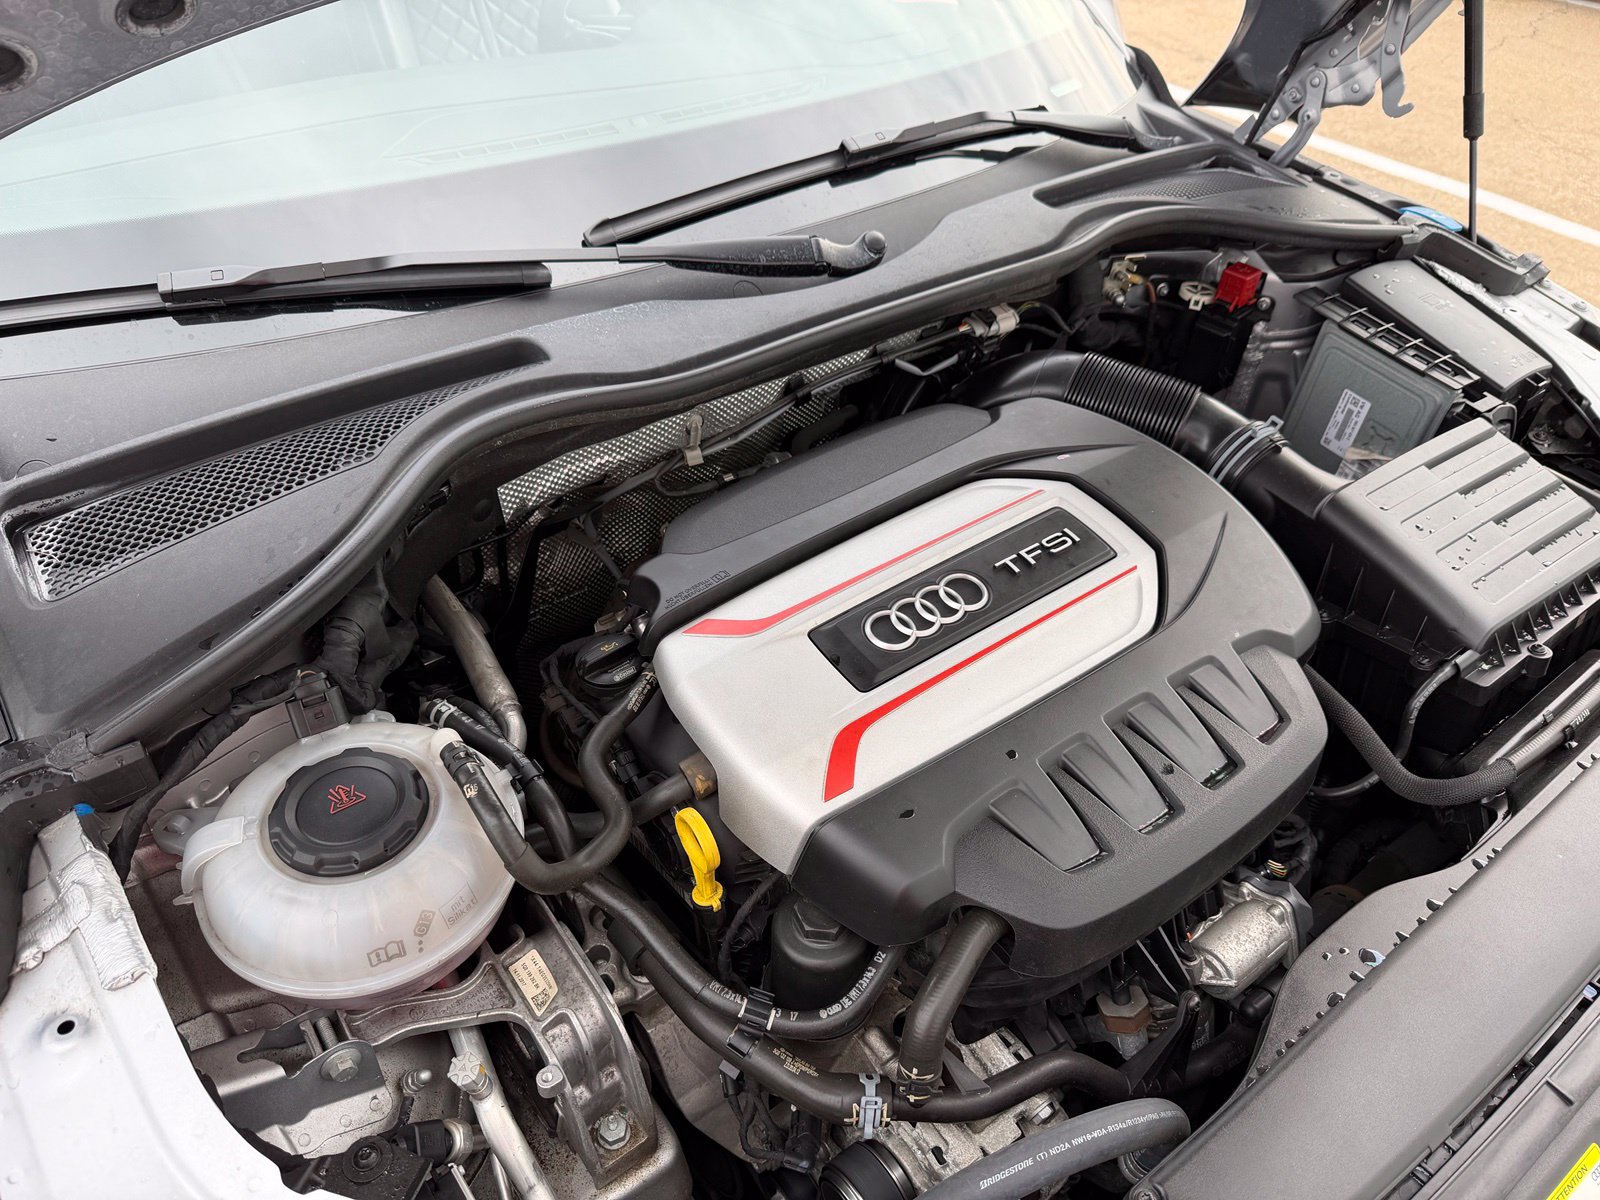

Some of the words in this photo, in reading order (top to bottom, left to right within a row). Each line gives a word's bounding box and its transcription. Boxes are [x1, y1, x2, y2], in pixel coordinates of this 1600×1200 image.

[993, 527, 1081, 574] TFSI
[447, 898, 478, 925] Silikat
[451, 896, 464, 912] mit
[415, 912, 433, 935] G13
[980, 1157, 1034, 1189] BRIDGESTONE
[1036, 1151, 1048, 1162] (T)
[1050, 1143, 1071, 1156] ND2A
